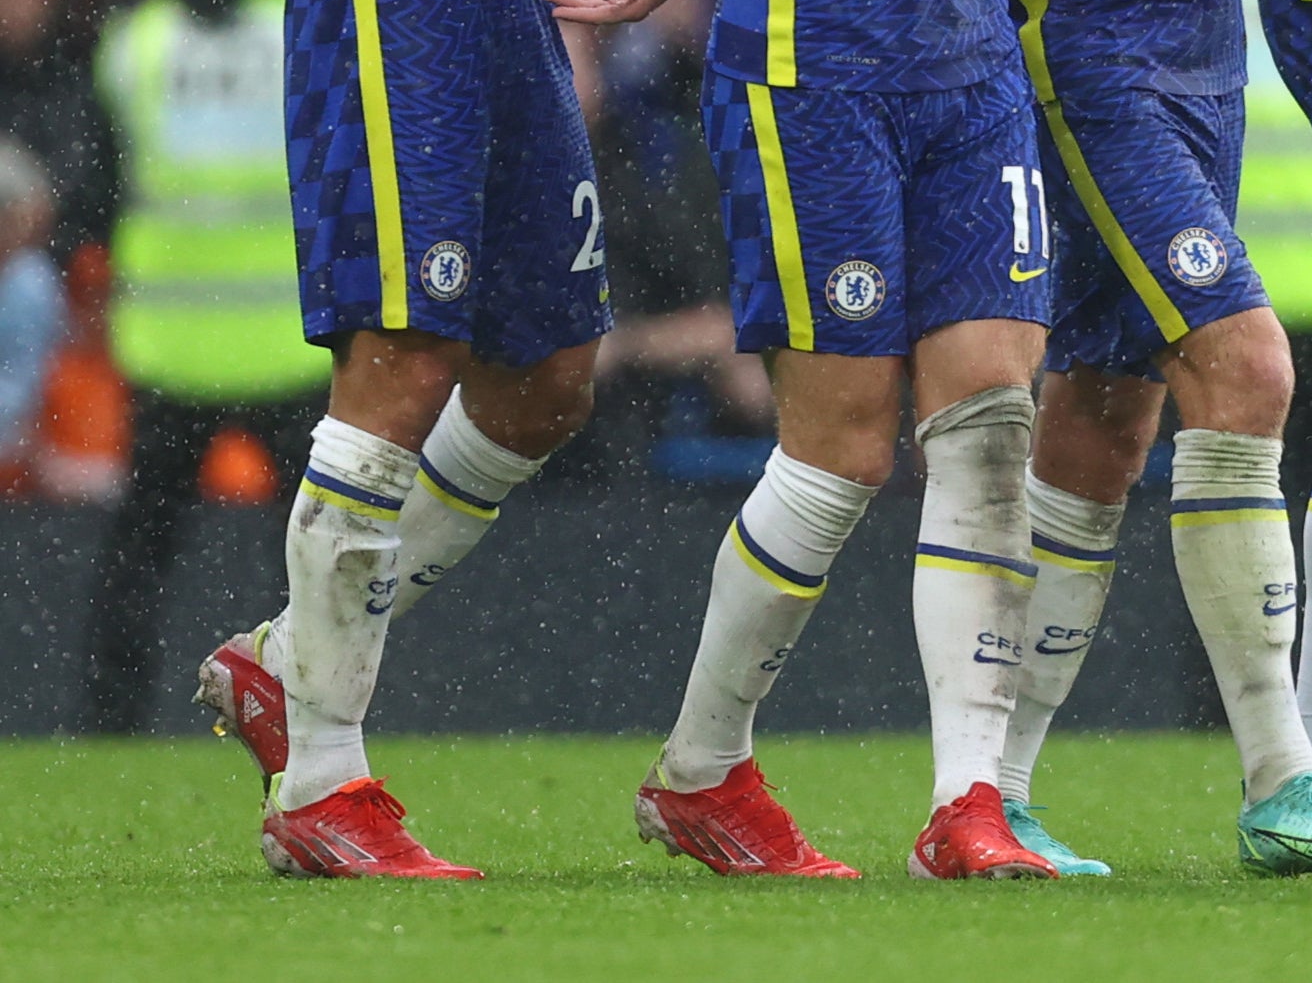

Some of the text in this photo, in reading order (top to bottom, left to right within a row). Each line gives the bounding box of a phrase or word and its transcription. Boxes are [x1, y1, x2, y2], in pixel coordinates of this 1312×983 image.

[1001, 166, 1049, 260] 11
[570, 180, 604, 272] 2
[1172, 230, 1207, 250] CHELSEA
[432, 244, 466, 258] CHELSEA
[837, 264, 876, 277] CHELSEA
[368, 575, 399, 594] CF
[1045, 625, 1097, 640] CFC
[977, 632, 1022, 657] CFC
